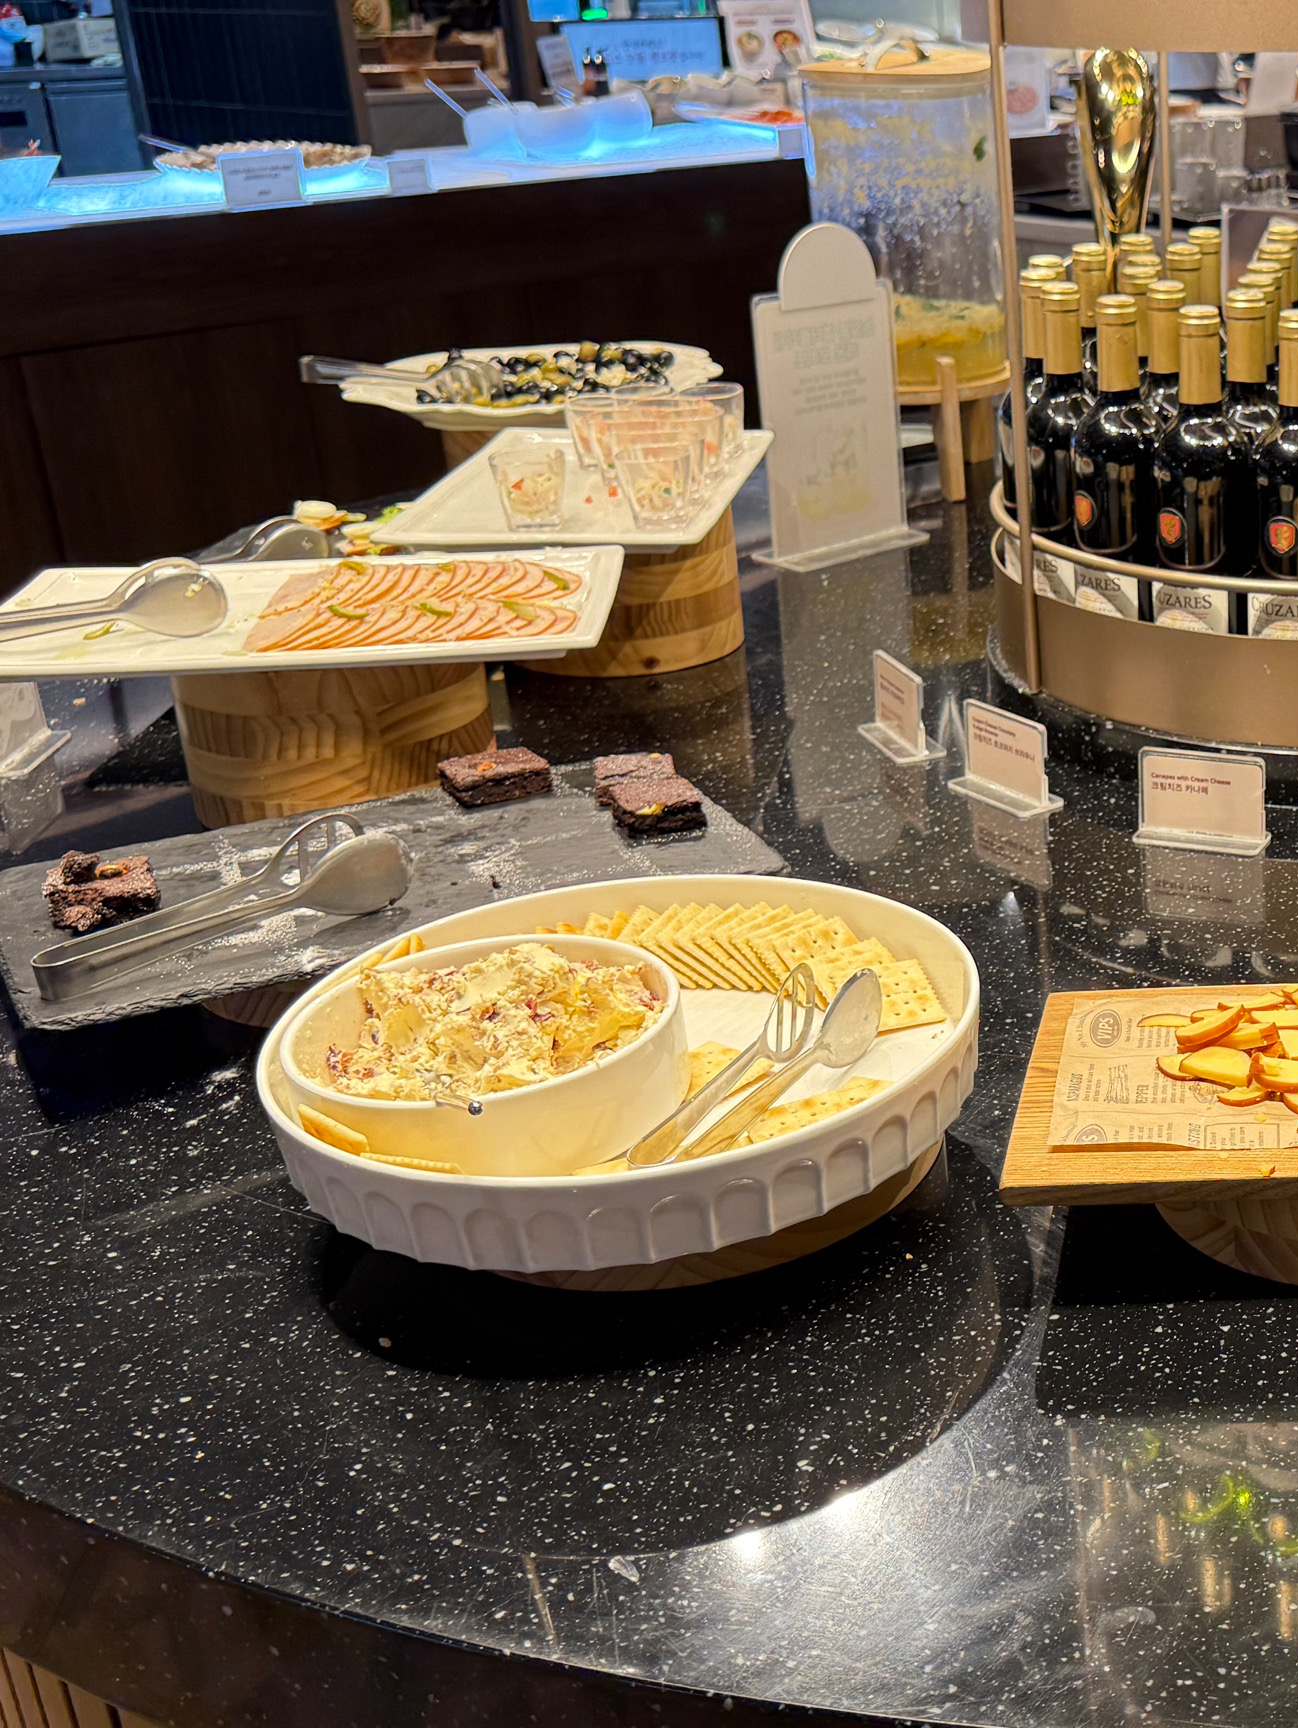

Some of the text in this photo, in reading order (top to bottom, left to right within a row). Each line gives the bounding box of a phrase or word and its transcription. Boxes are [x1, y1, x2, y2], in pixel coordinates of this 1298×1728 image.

[1151, 772, 1175, 780] Canapes
[1191, 776, 1208, 784] Cream
[1210, 778, 1231, 786] Cheese
[1151, 782, 1209, 795] 크림치즈 카나페
[1097, 1017, 1113, 1039] VIPS
[1067, 1073, 1083, 1102] ASPARAGUS
[1135, 1084, 1149, 1104] PEPPER
